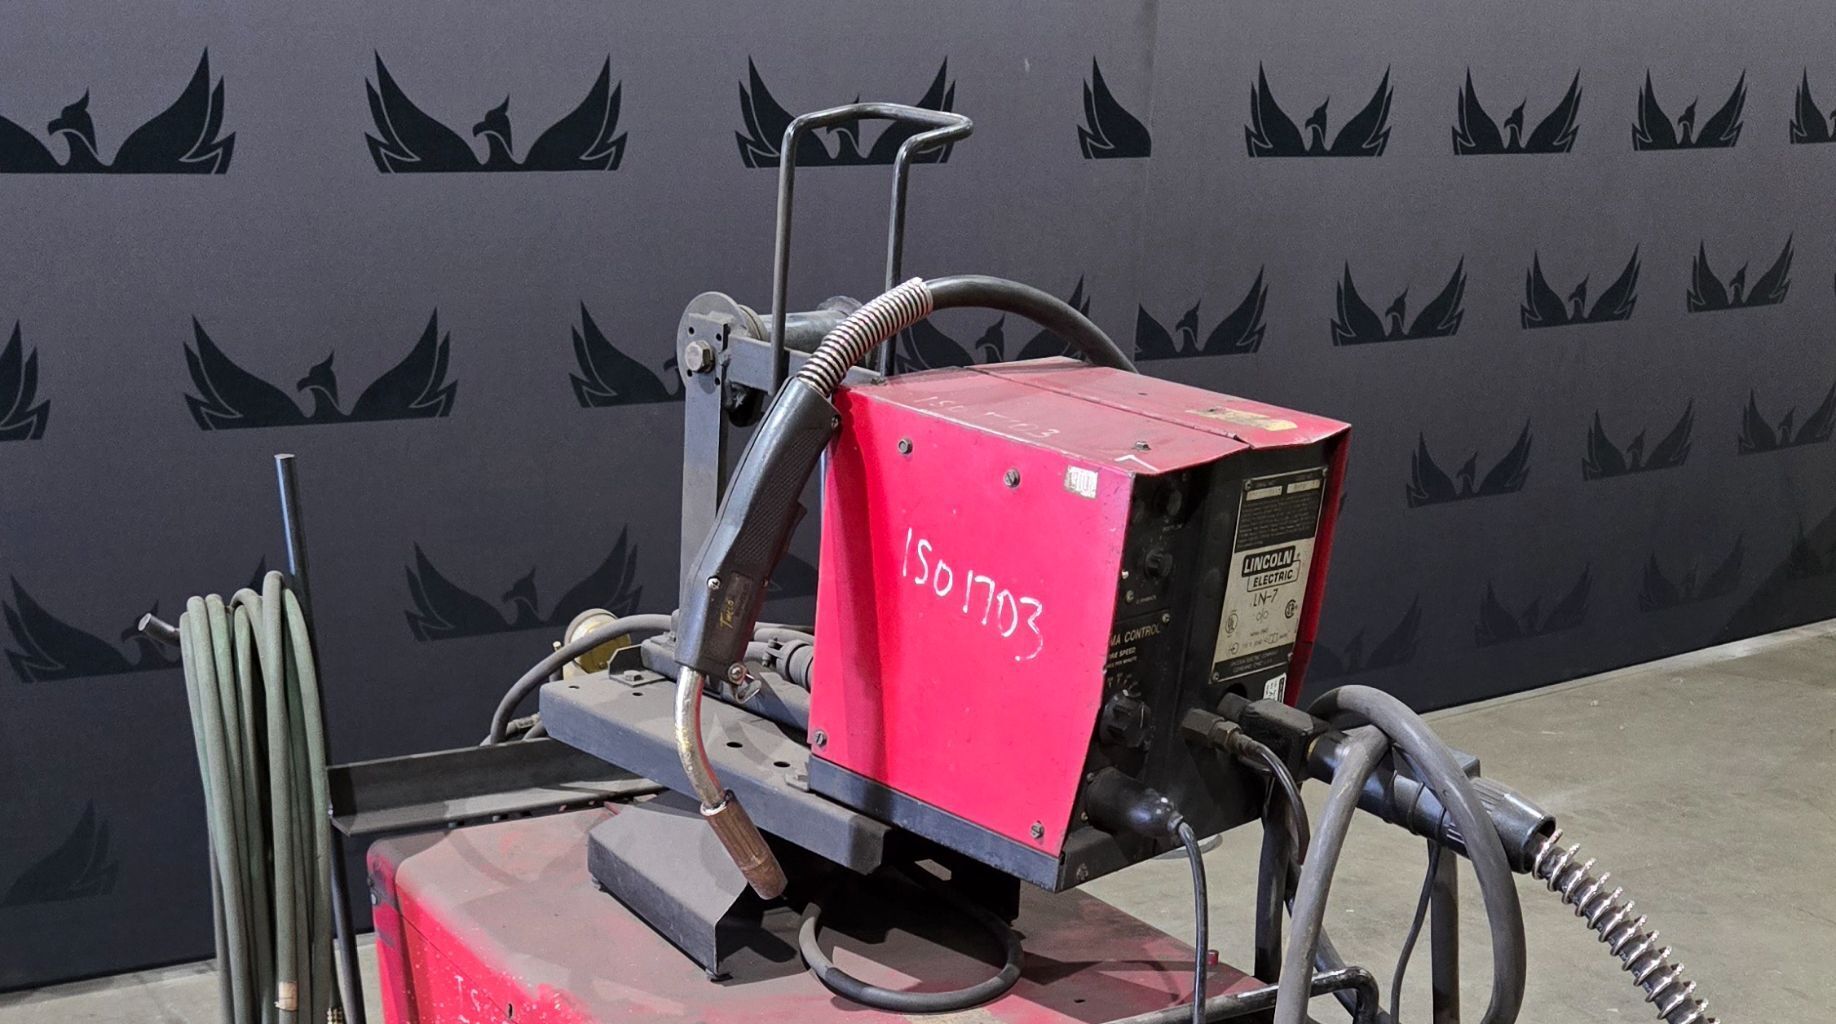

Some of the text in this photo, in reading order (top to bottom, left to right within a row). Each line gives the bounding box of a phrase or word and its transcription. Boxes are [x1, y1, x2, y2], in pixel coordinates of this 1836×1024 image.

[1244, 546, 1293, 574] LINCOLN
[1252, 568, 1294, 588] ELECTRIC
[1253, 588, 1279, 607] LN-7
[962, 570, 1044, 661] 1703
[1124, 623, 1161, 643] CONTROL
